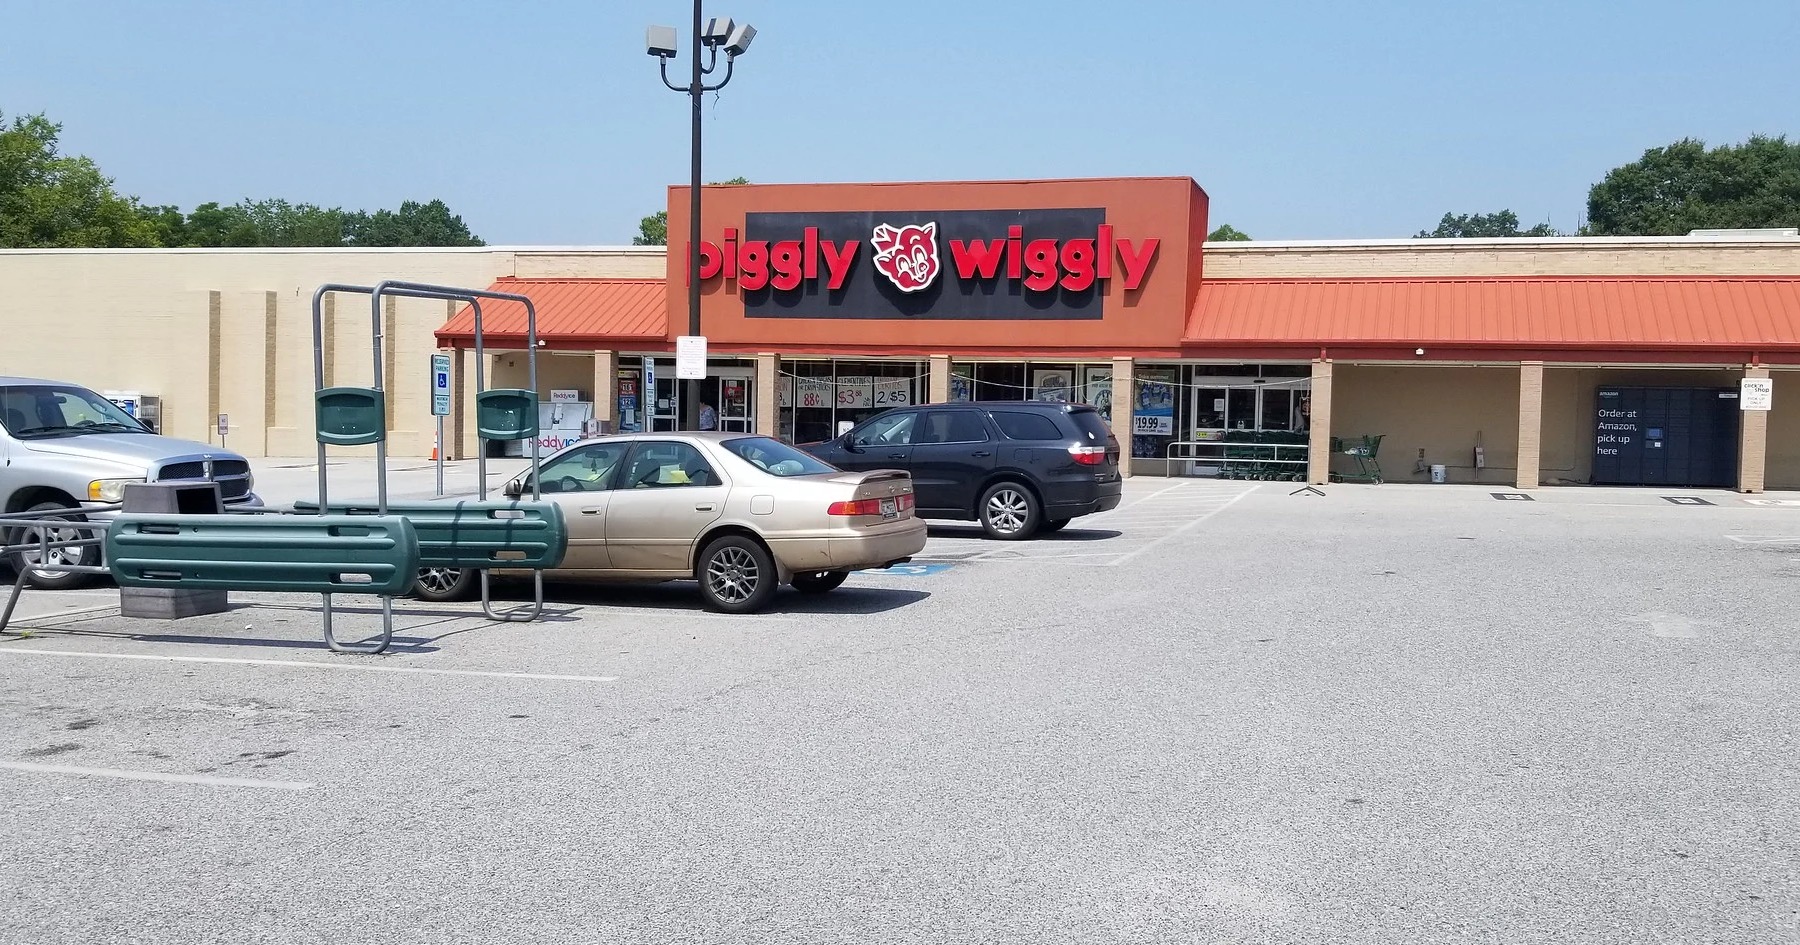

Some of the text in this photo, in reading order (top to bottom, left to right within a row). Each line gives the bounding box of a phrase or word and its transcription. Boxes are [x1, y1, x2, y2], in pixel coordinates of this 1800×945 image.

[685, 223, 1160, 291] piggly wiggly
[1598, 409, 1637, 418] Order at
[1597, 422, 1637, 431] Amazon,
[1597, 434, 1630, 445] pick up
[1597, 446, 1618, 455] here
